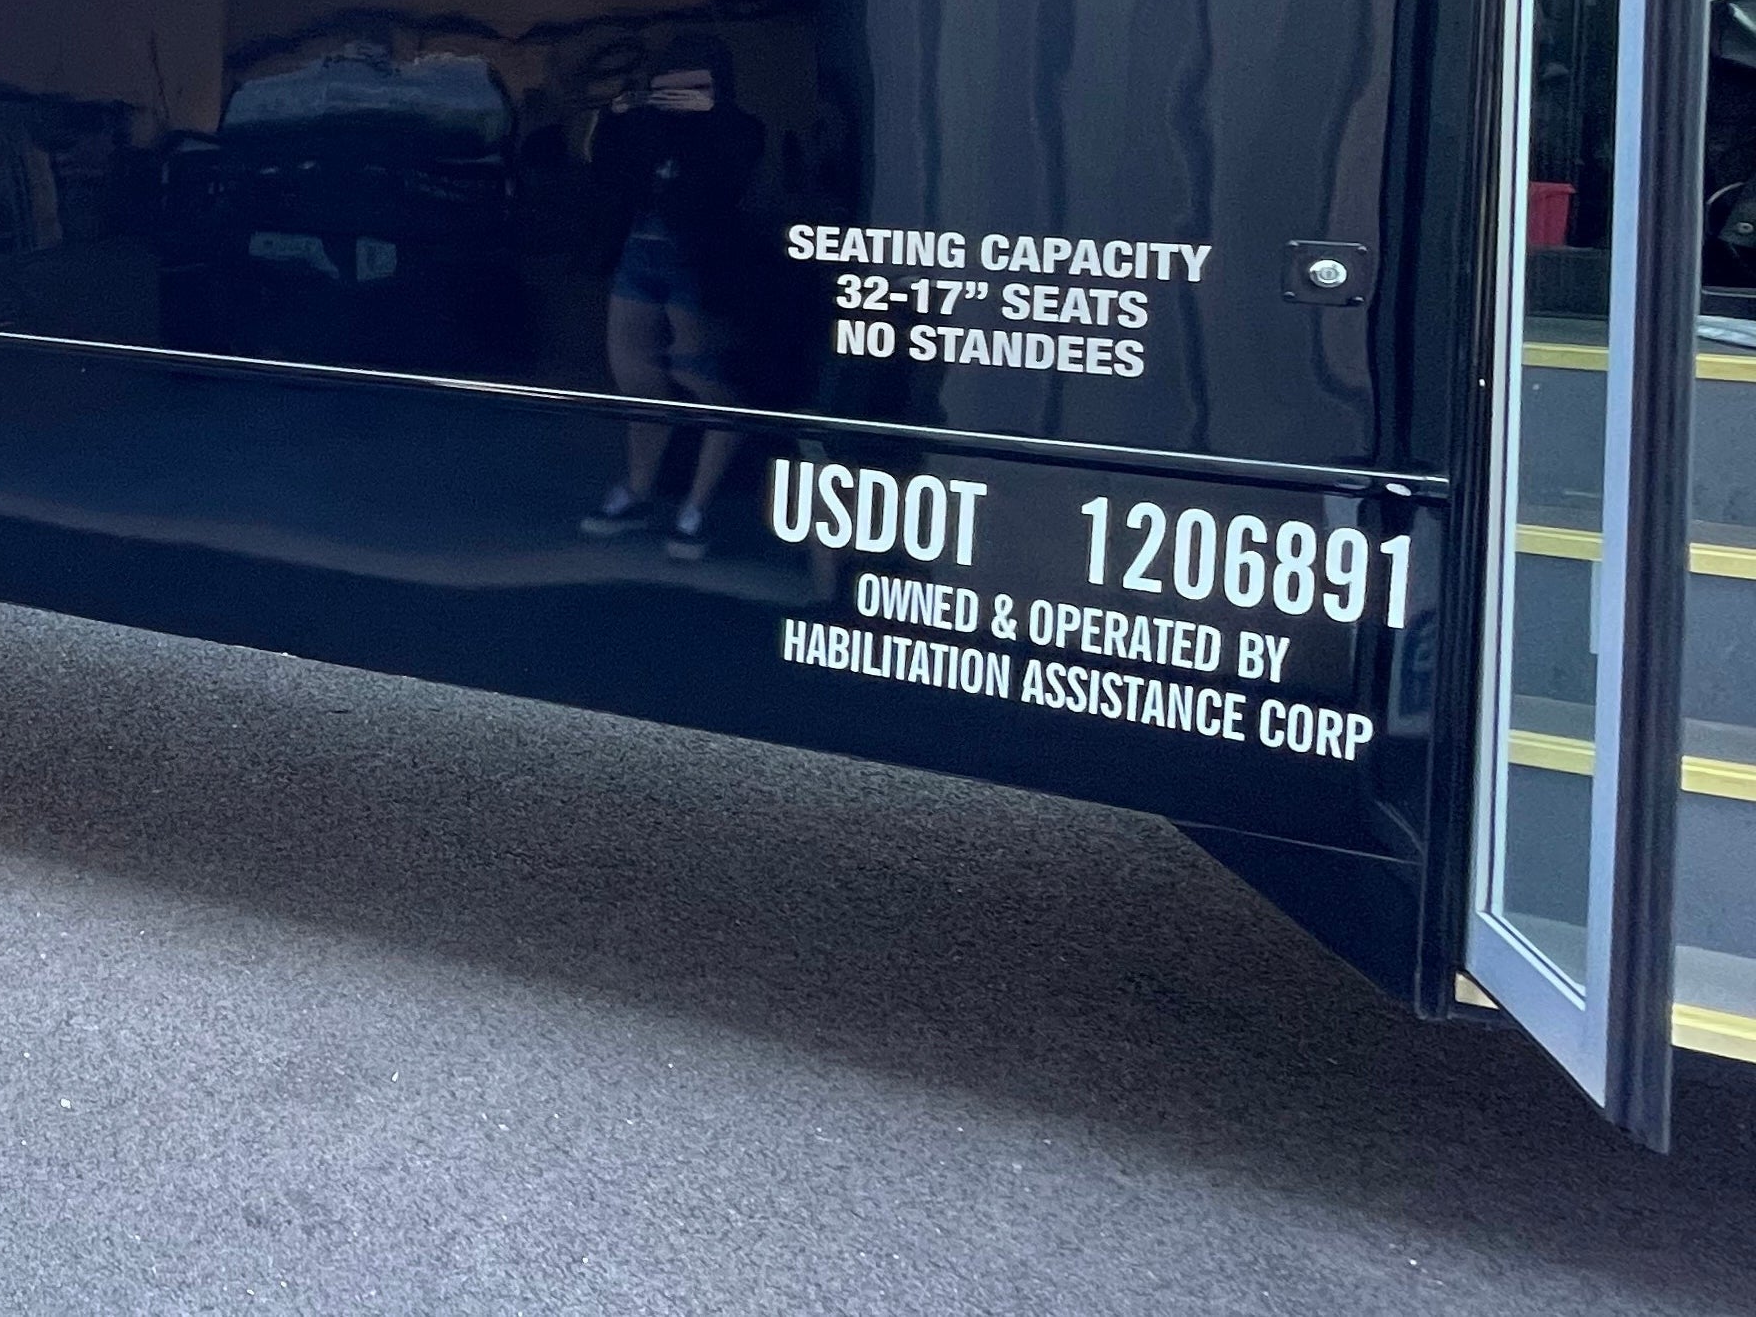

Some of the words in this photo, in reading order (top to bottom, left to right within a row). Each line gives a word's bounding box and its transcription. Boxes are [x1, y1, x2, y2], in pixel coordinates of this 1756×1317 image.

[787, 224, 966, 269] SEATING
[980, 233, 1213, 282] CAPACITY
[1001, 283, 1148, 329] SEATS
[836, 319, 896, 358] NO
[908, 324, 1145, 378] STANDEES
[772, 458, 988, 566] USDOT
[1081, 496, 1411, 629] 1206891
[857, 573, 979, 633] OWNED
[990, 593, 1018, 641] &
[1029, 599, 1222, 672] OPERATED
[1237, 630, 1290, 683] BY
[783, 618, 1011, 699] HABILITATION
[1020, 659, 1247, 742] ASSISTANCE
[1259, 698, 1374, 761] CORP
